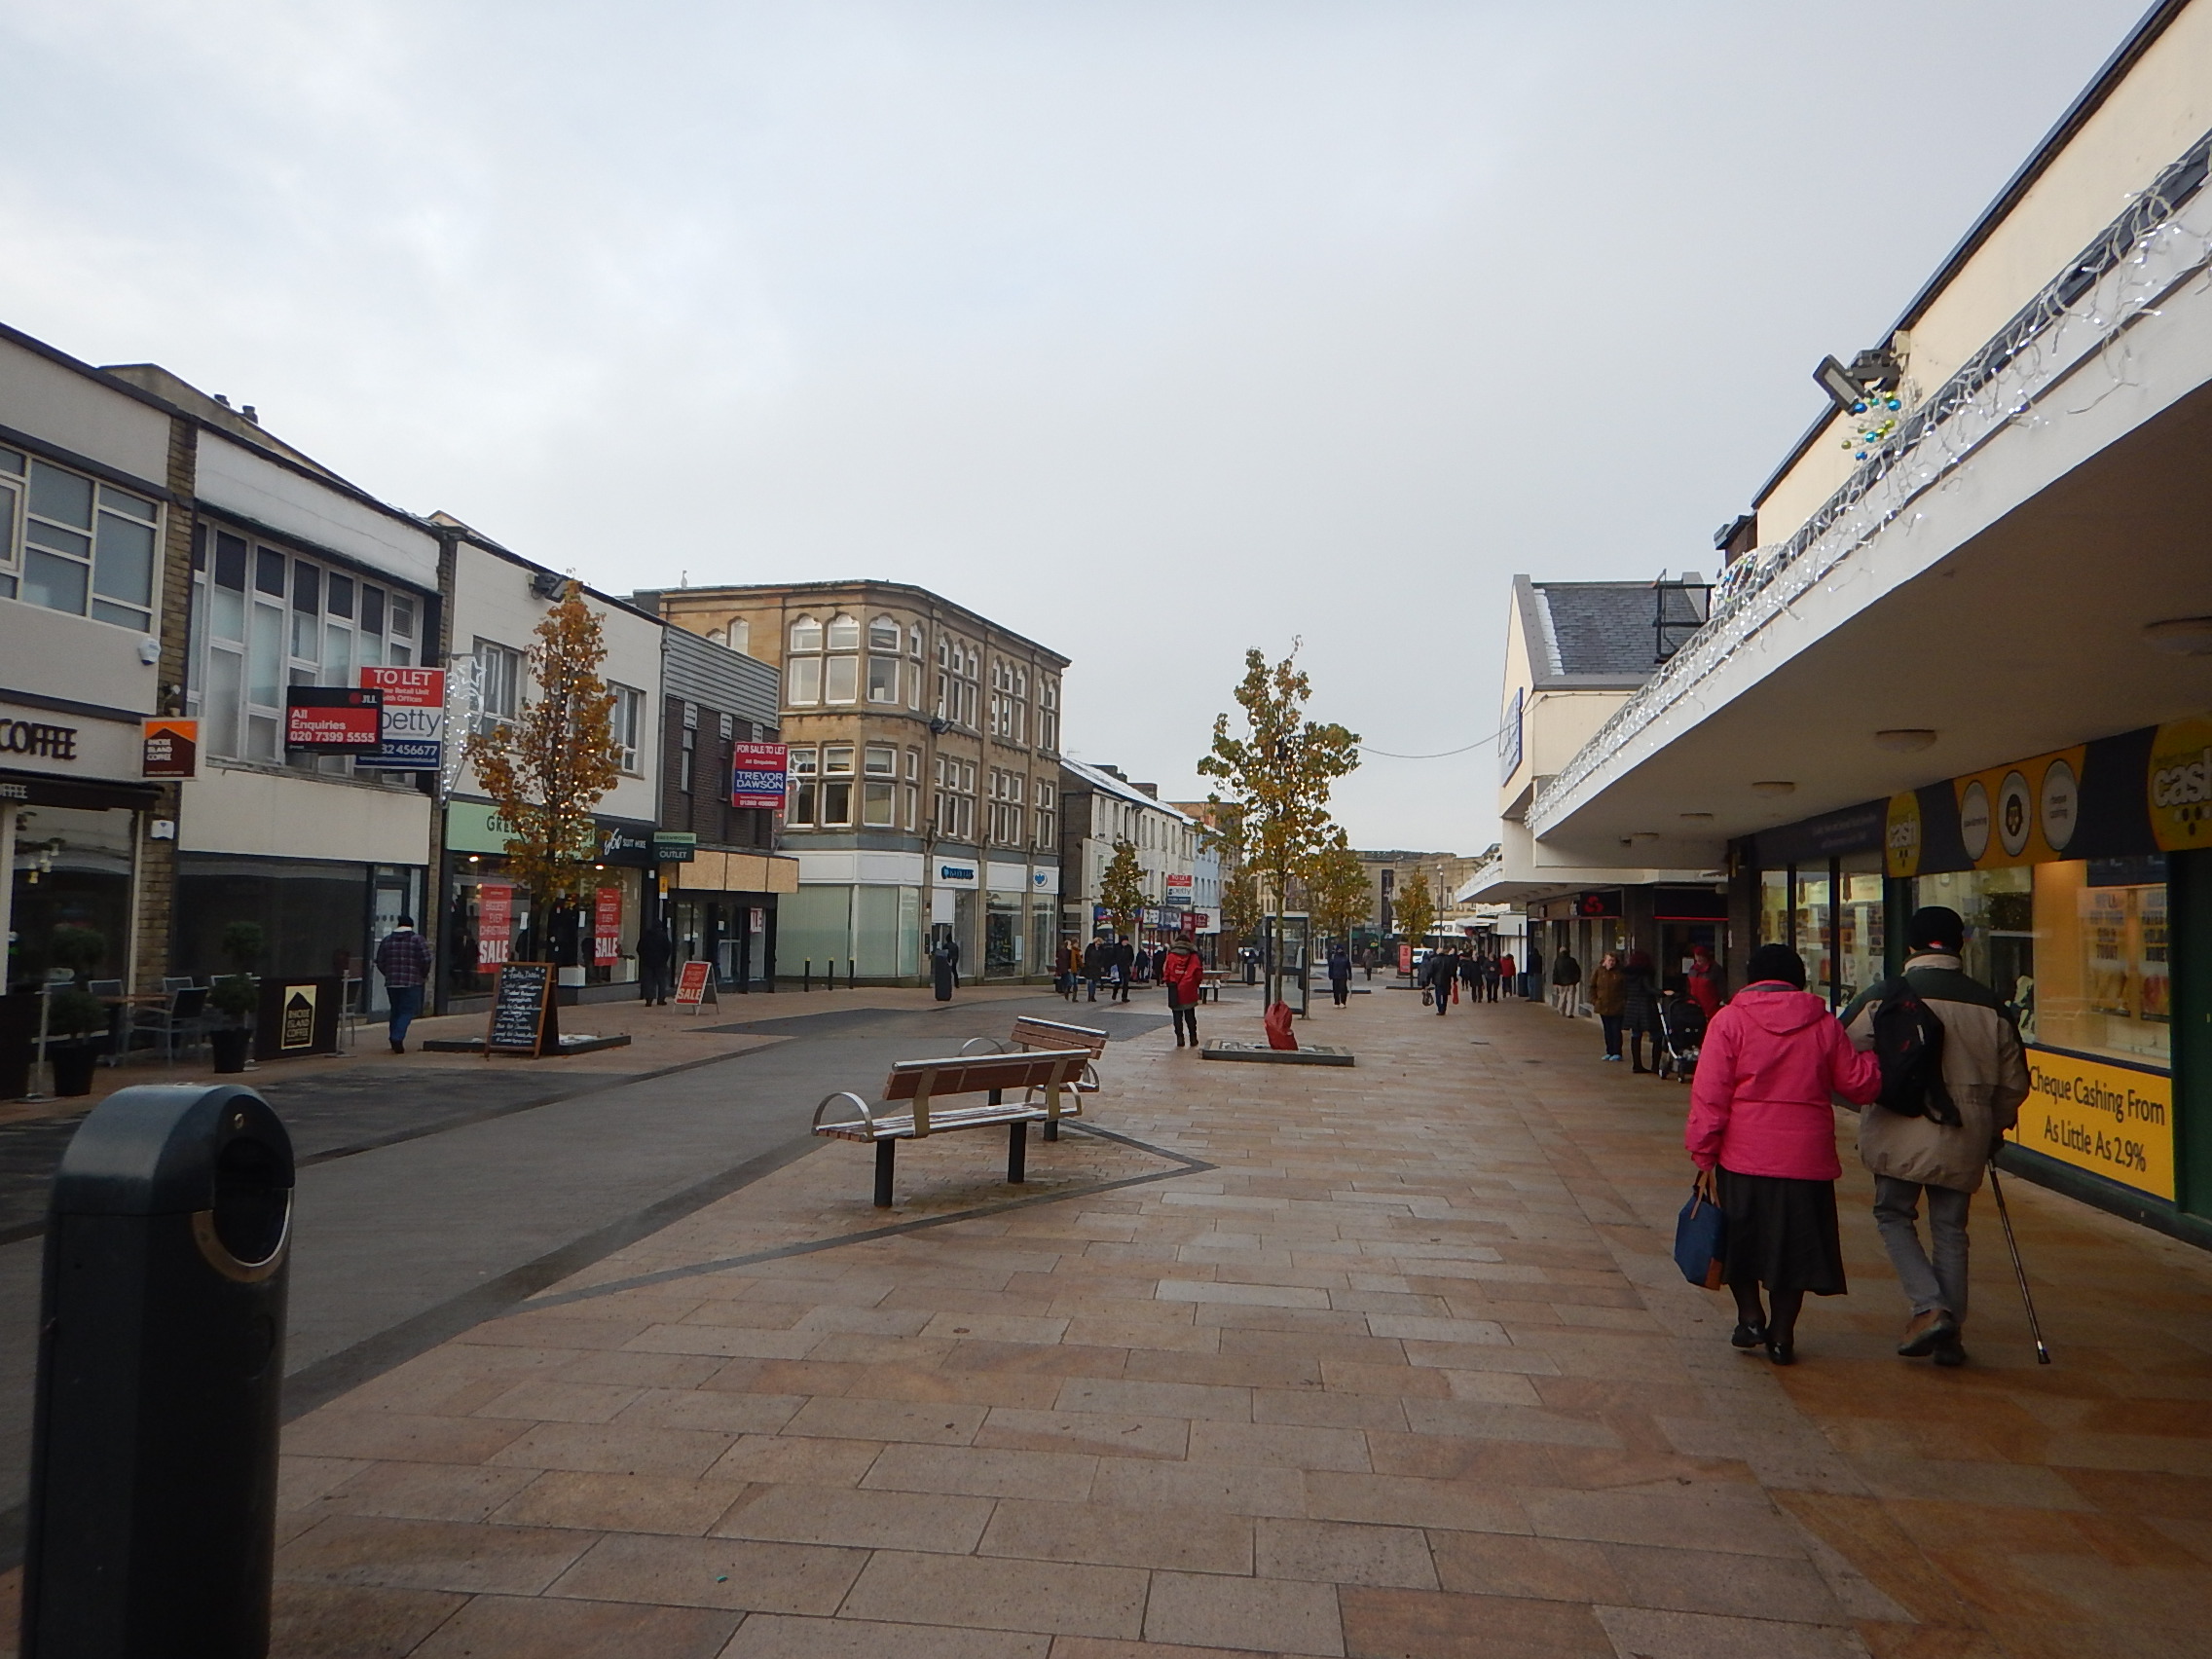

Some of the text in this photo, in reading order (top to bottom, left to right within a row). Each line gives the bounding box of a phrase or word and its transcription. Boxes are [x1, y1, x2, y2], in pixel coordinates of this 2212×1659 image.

[374, 670, 432, 686] TO LET
[361, 694, 378, 704] JLL
[292, 709, 308, 719] All
[292, 719, 347, 732] Enquiries
[290, 731, 312, 742] 020
[315, 732, 344, 742] 7399
[347, 732, 376, 744] 5555
[395, 744, 438, 756] 456677
[736, 745, 786, 756] FOR SALE TO LET
[736, 771, 784, 782] TREVOR
[736, 779, 784, 790] DAWSON
[659, 850, 687, 859] OUTLET
[479, 940, 509, 964] SALE
[595, 937, 618, 958] SALE
[677, 988, 702, 1000] SALE
[2029, 1065, 2165, 1126] Cheque Cashing From
[2044, 1115, 2148, 1173] As Little As 2.9%
